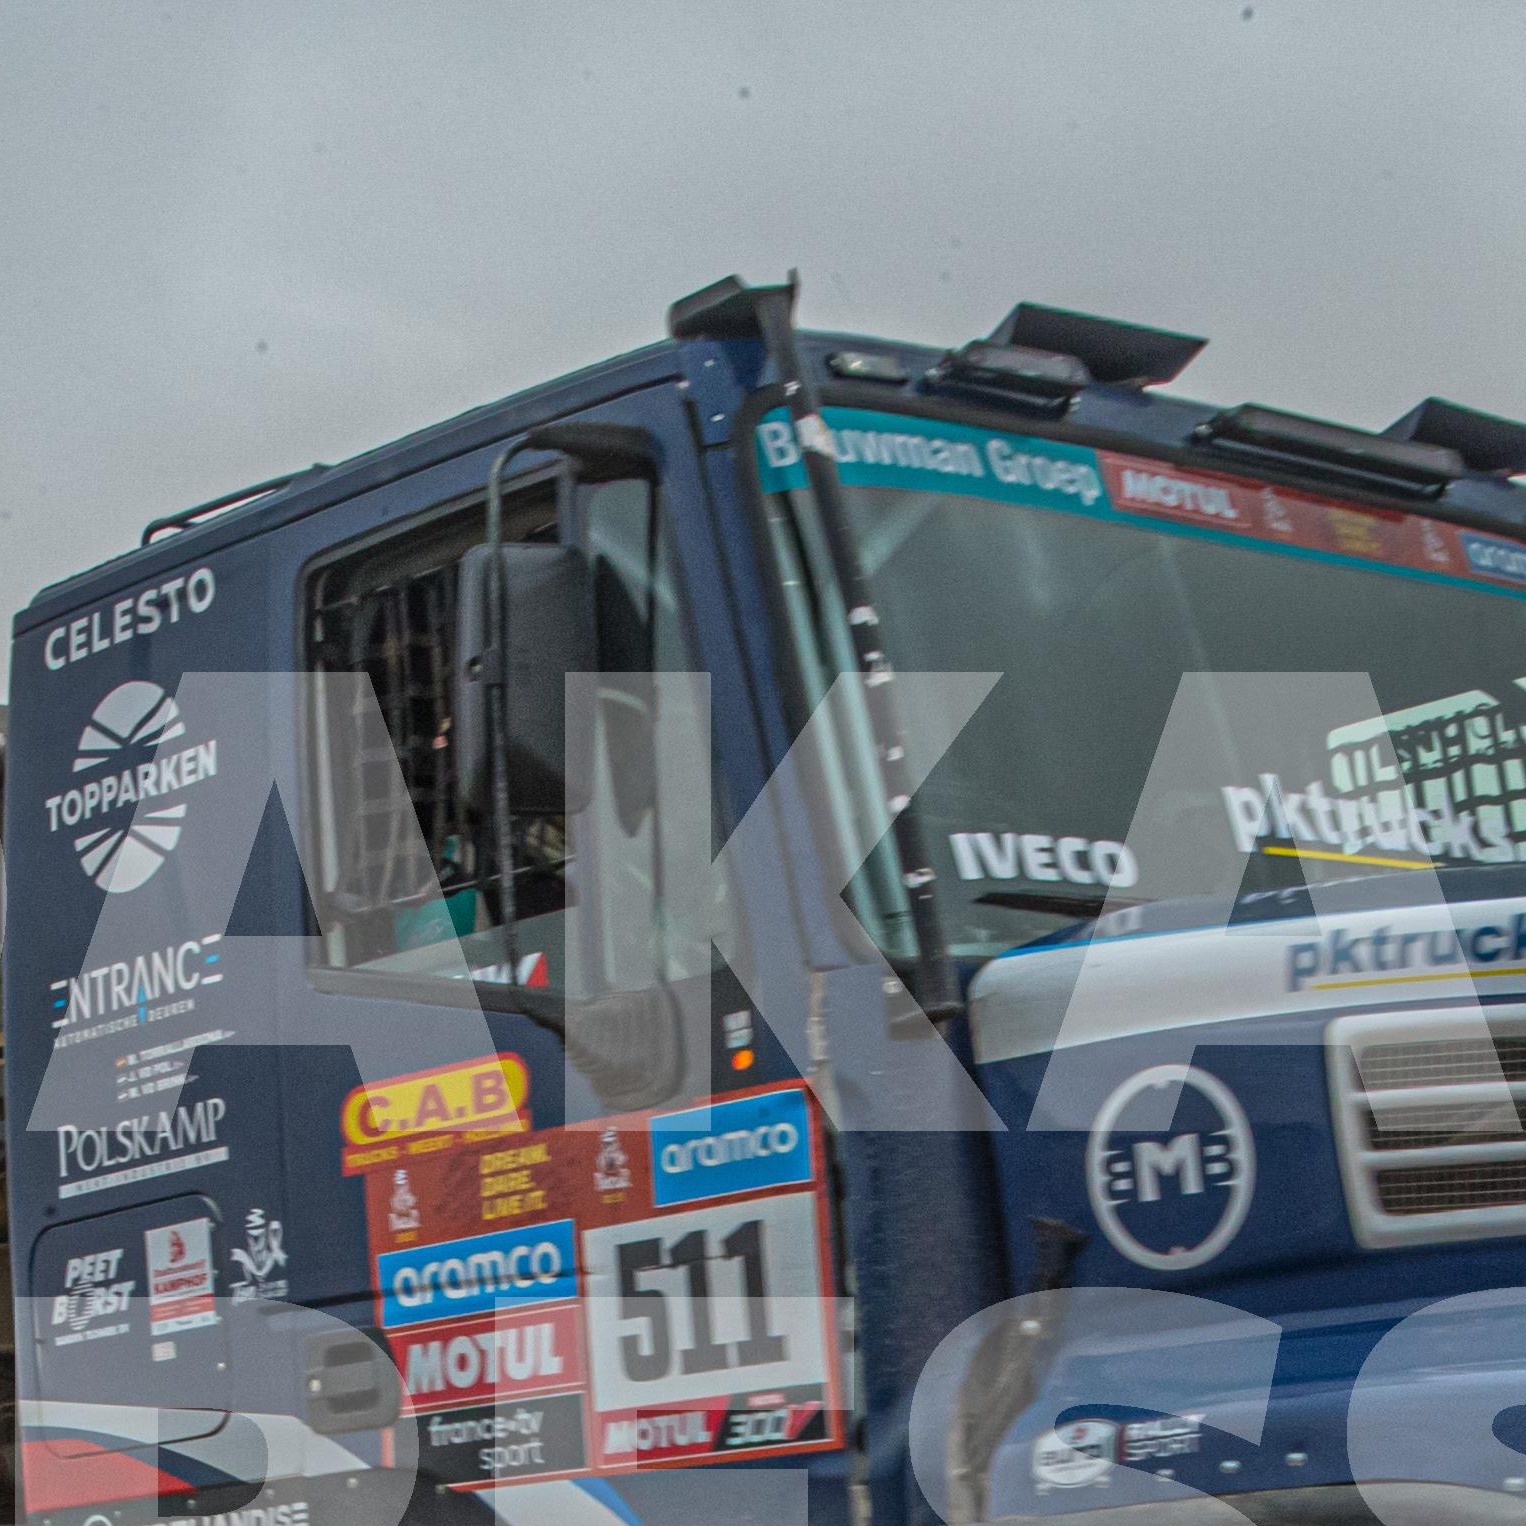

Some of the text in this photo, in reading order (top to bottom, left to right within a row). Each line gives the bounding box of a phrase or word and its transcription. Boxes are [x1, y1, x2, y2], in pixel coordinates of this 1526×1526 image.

[756, 421, 1103, 506] Buwman Groep
[1122, 468, 1239, 519] MOTUL
[44, 567, 216, 671] CELESTO
[45, 739, 218, 832] TOPPARKEN
[949, 831, 1138, 888] IVECO
[50, 933, 223, 1029] ENTRANCE
[57, 1097, 225, 1177] POLSKAMP
[661, 1123, 799, 1174] aramco
[65, 1248, 124, 1289] PEET
[393, 1241, 561, 1307] aramco
[614, 1219, 791, 1383] 511
[406, 1323, 565, 1396] MOTUL
[479, 1438, 545, 1471] sport
[603, 1411, 712, 1455] MOTUL
